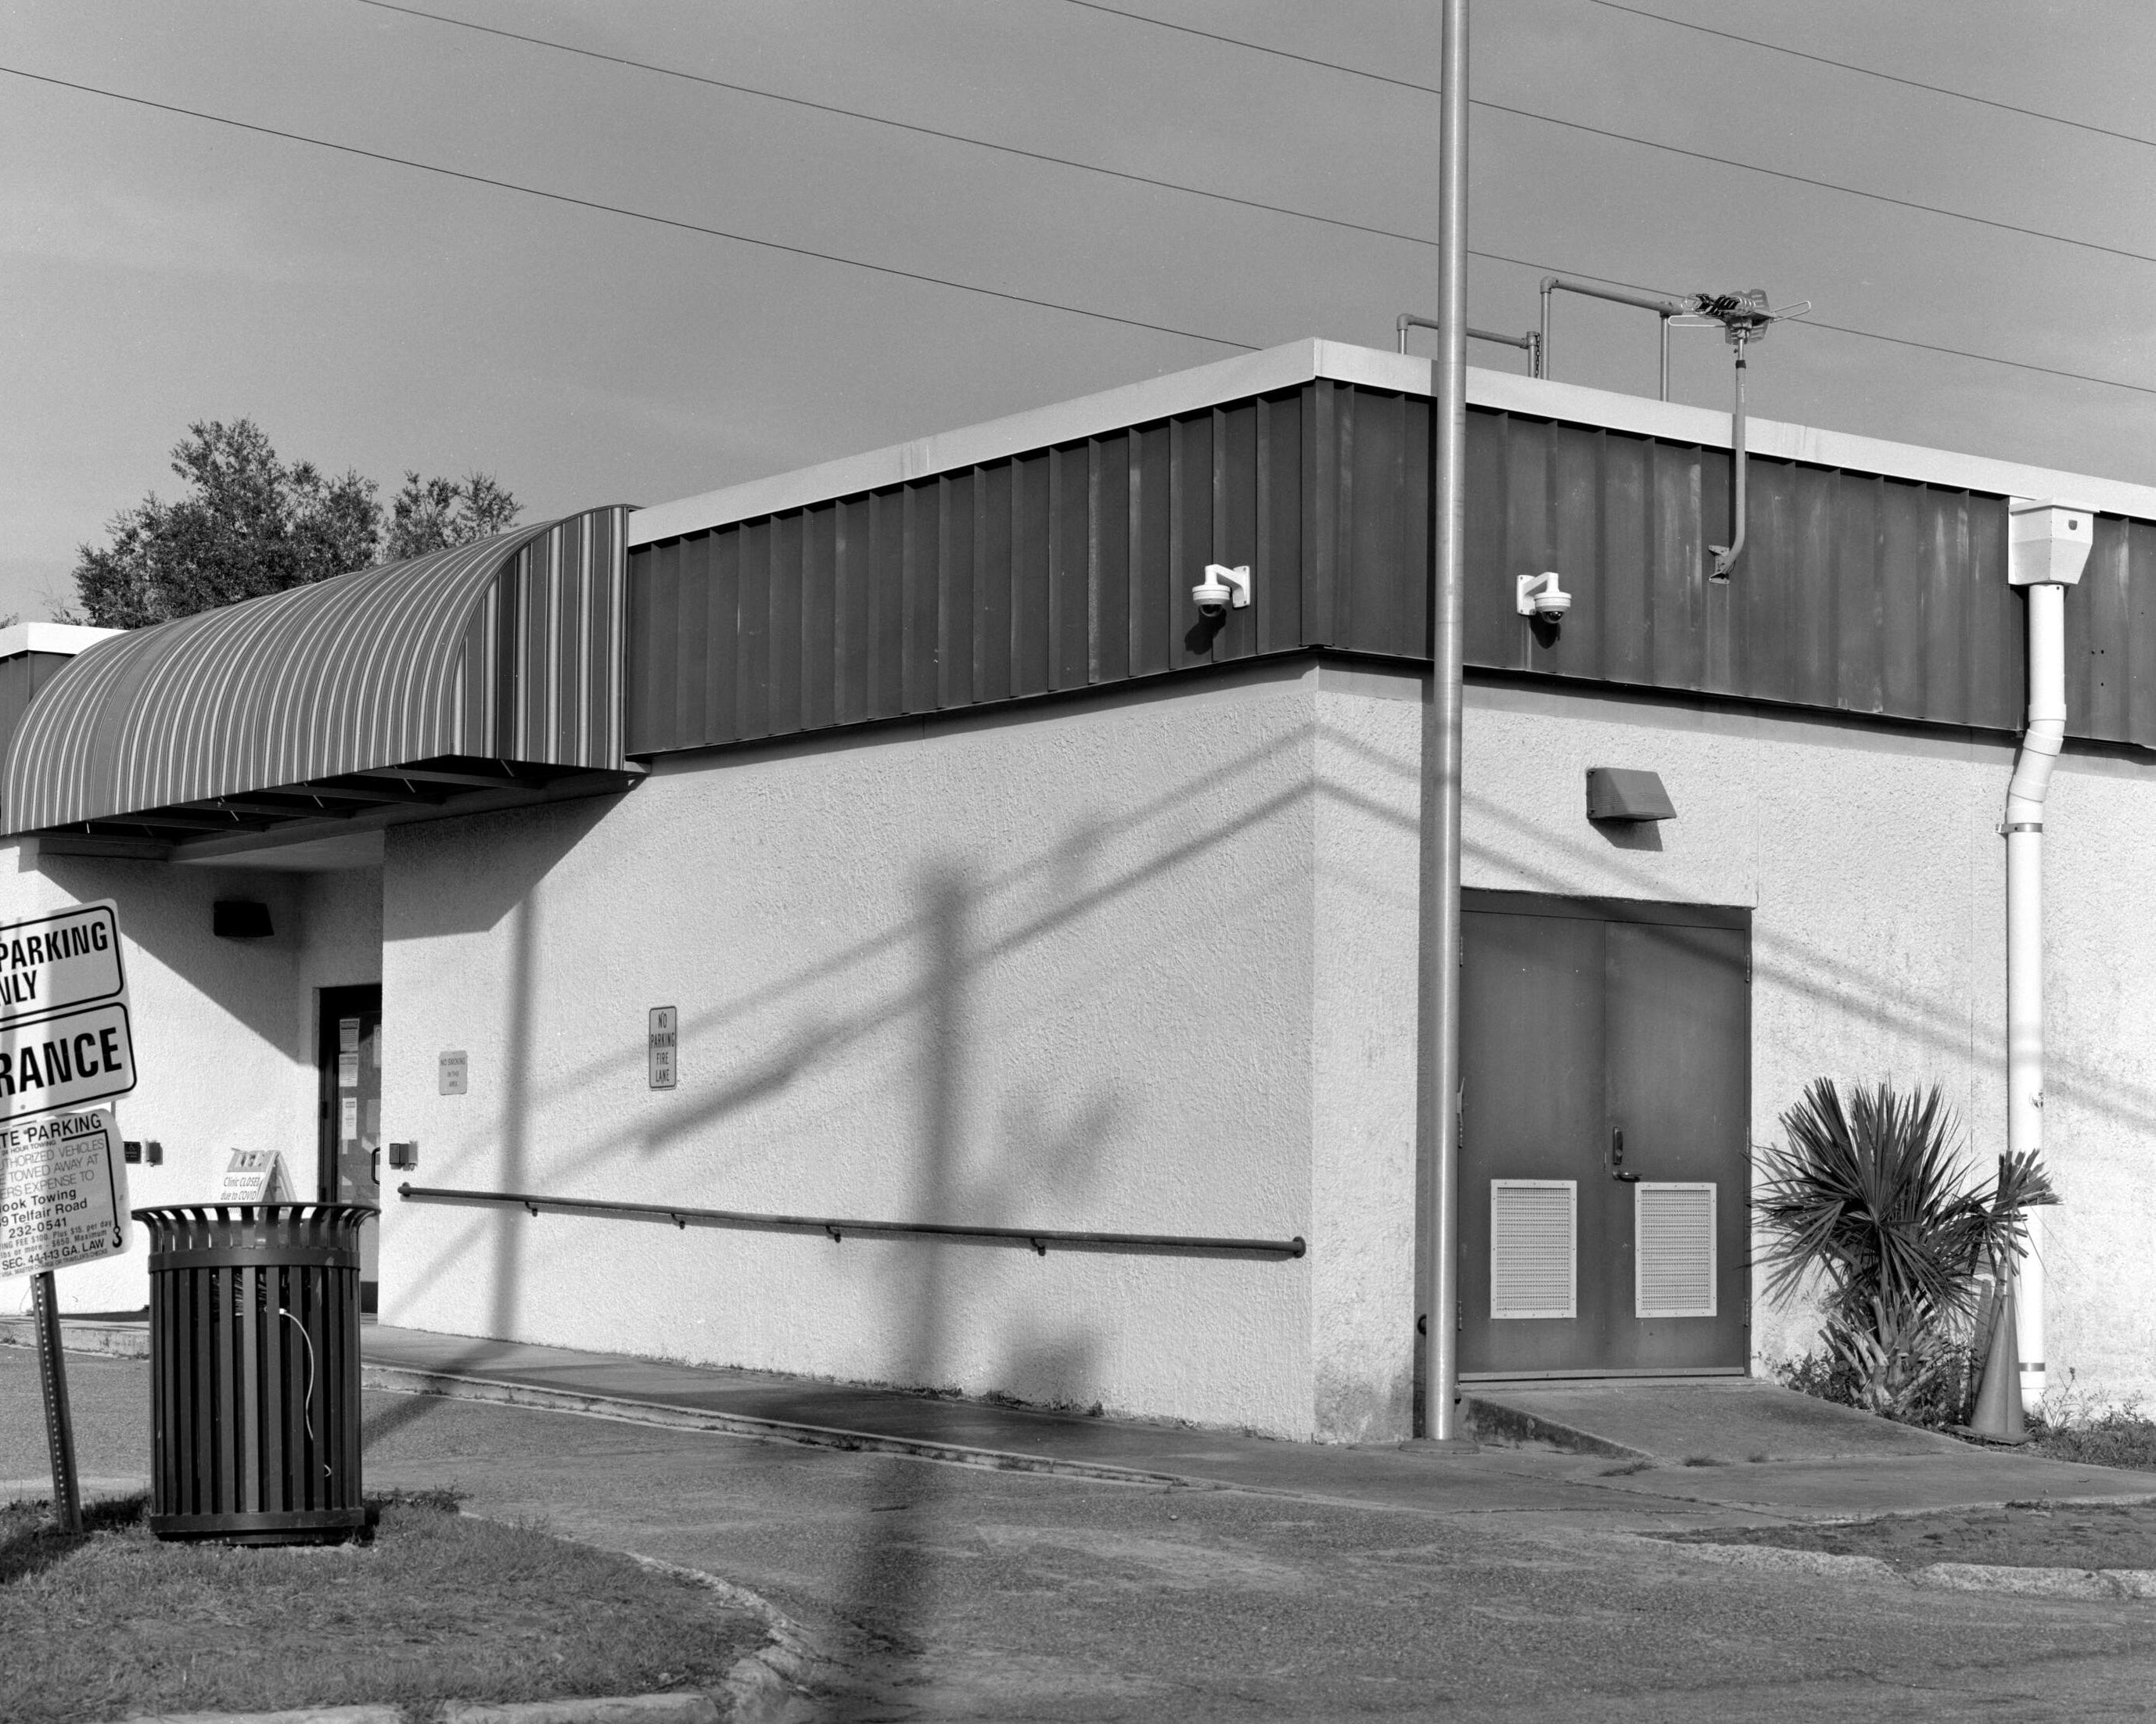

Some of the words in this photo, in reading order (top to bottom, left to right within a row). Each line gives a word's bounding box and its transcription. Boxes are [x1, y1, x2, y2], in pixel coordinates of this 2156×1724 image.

[0, 921, 108, 972] PARKING
[658, 1013, 667, 1029] NO
[650, 1033, 675, 1049] PARKING
[656, 1052, 669, 1065] FIRE
[656, 1069, 670, 1082] LANE
[0, 1130, 20, 1148] TE
[27, 1113, 102, 1142] PARKING
[10, 1145, 29, 1154] HOUR
[31, 1140, 56, 1149] TOWING
[59, 1138, 105, 1158] VEHICLES
[9, 1165, 51, 1183] TOWED
[54, 1157, 84, 1173] AWAY
[87, 1153, 99, 1166] AT
[24, 1173, 77, 1194] EXPENSE
[79, 1169, 95, 1182] TO
[223, 1176, 239, 1187] Clinic
[0, 1198, 27, 1214] ook
[31, 1189, 77, 1205] Towing
[220, 1191, 232, 1201] due
[232, 1191, 239, 1201] to
[239, 1191, 257, 1201] COVID
[11, 1207, 52, 1224] Telfair
[55, 1197, 87, 1215] Road
[9, 1217, 66, 1239] 232-0541
[16, 1237, 29, 1247] FEE
[52, 1230, 67, 1239] Plus
[86, 1223, 97, 1232] per
[2, 1257, 26, 1270] SEC.
[28, 1249, 59, 1264] 44-1-13
[62, 1245, 81, 1257] GA.
[82, 1238, 104, 1252] LAW
